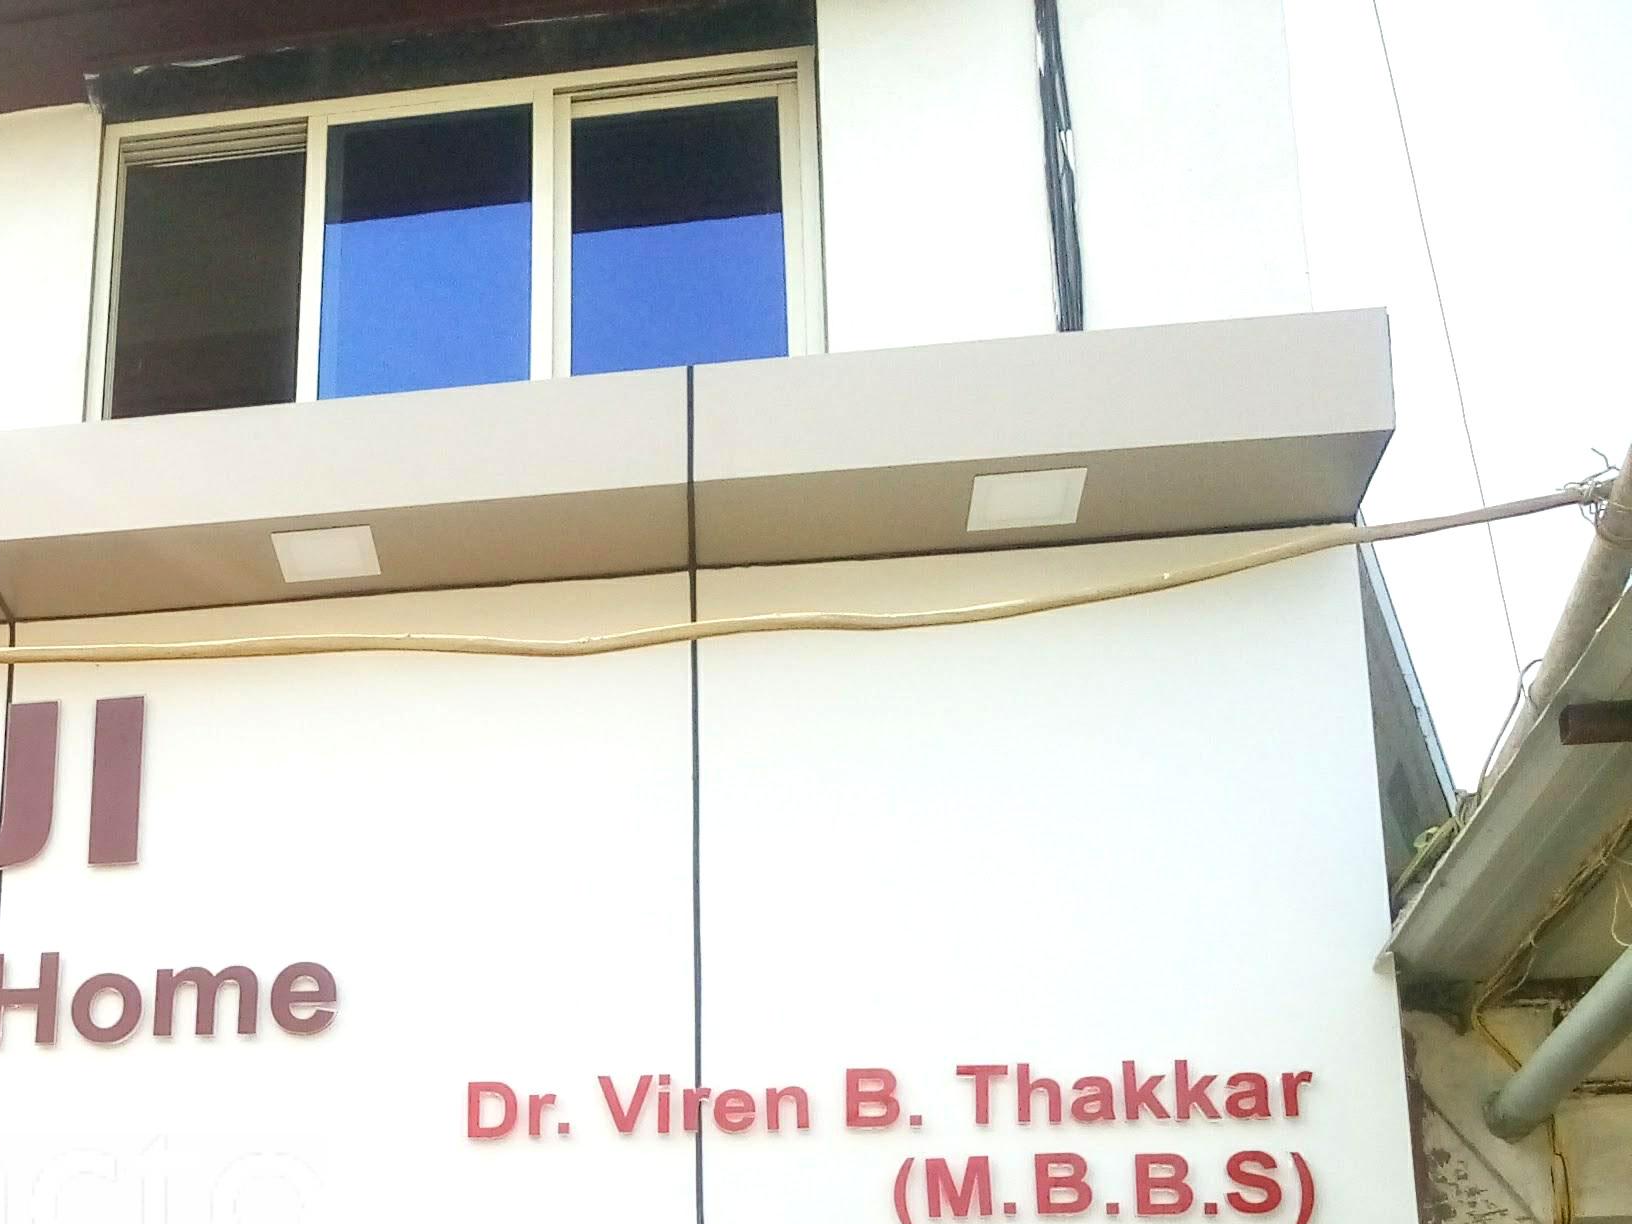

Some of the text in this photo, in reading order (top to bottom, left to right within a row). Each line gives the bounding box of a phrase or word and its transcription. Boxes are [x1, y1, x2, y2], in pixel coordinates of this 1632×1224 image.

[467, 1060, 1313, 1141] Dr. Viren B. Thakkar
